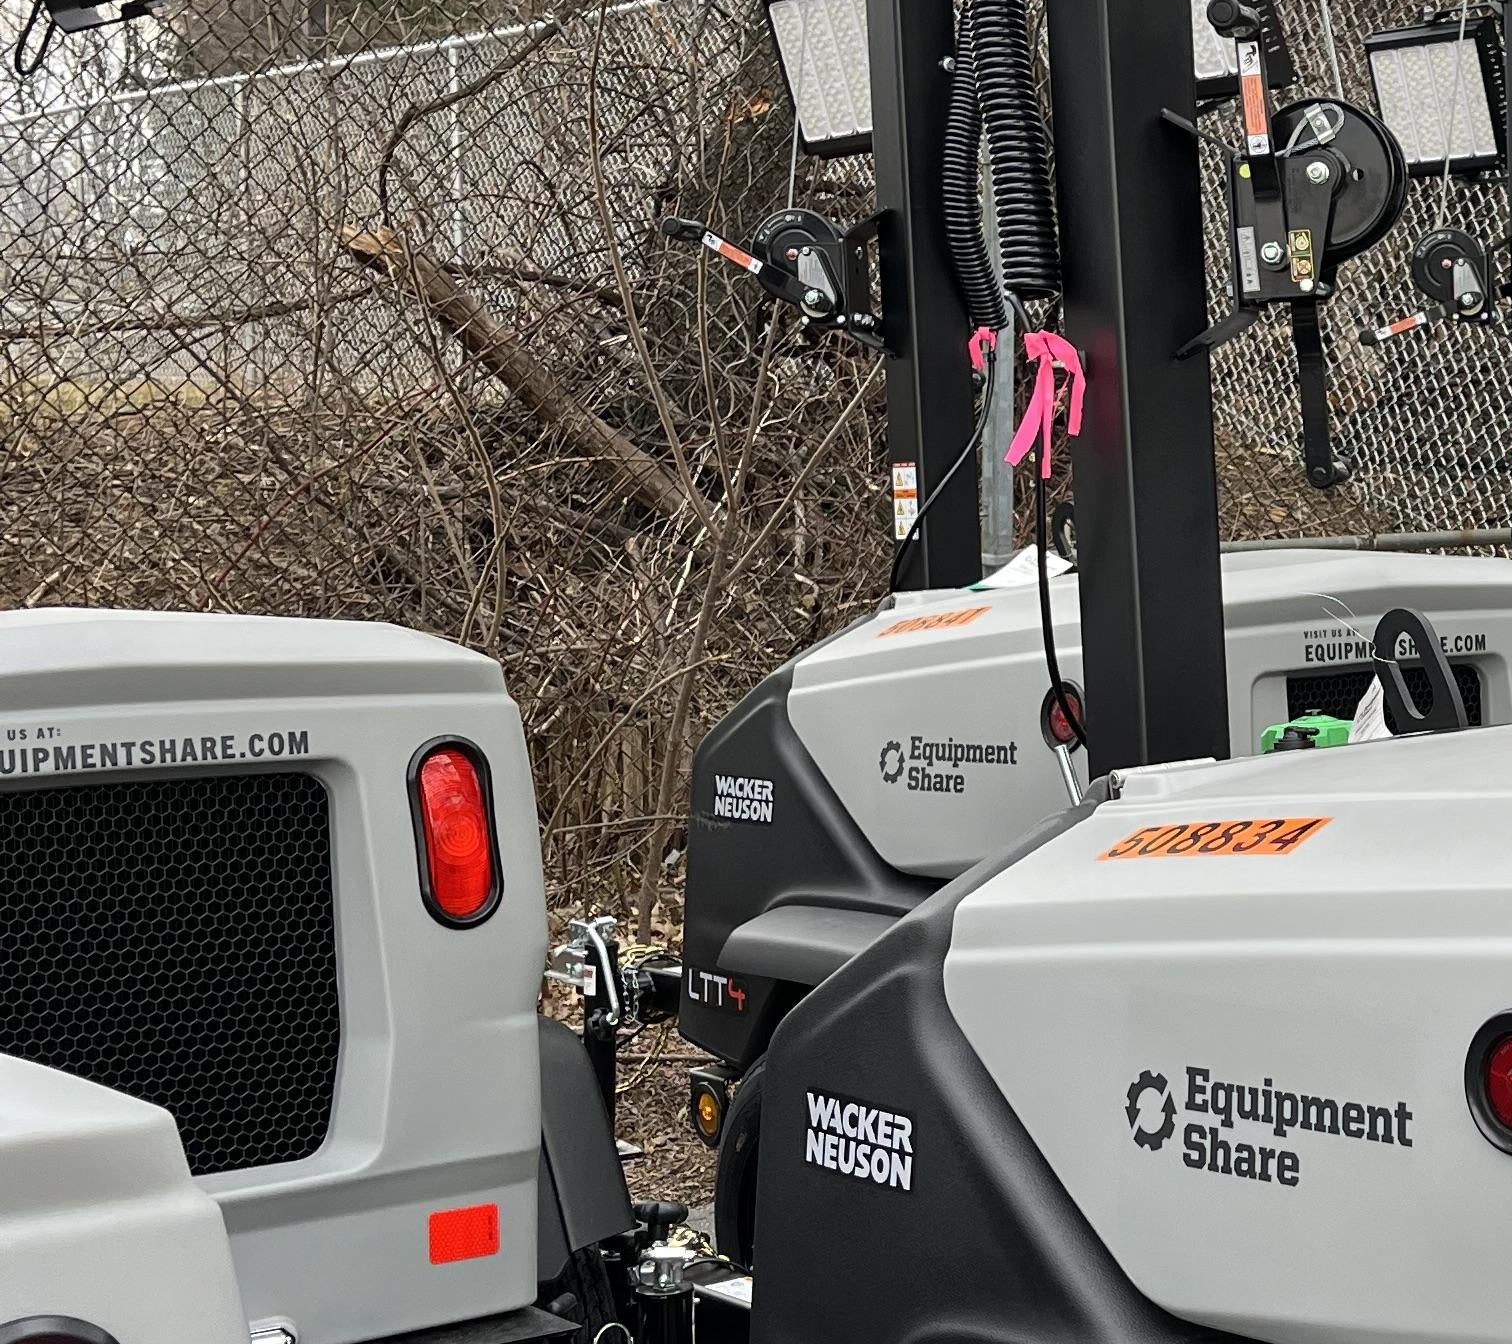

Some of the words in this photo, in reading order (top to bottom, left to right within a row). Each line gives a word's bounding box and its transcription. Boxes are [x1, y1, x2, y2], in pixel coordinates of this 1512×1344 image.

[1304, 629, 1327, 639] VISIT
[1331, 628, 1342, 638] US
[1305, 634, 1486, 662] EQUIPMSHE.COM
[7, 728, 27, 741] US
[36, 727, 61, 739] AT:
[909, 736, 1018, 768] Equipment
[715, 774, 773, 801] WACKER
[907, 766, 965, 793] Share
[714, 796, 773, 823] NEUSON
[1108, 819, 1322, 857] 508834
[689, 968, 746, 1010] LTT4
[806, 1092, 913, 1153] WACKER
[1185, 1066, 1413, 1147] Equipment
[806, 1128, 912, 1191] NEUSON
[1182, 1123, 1300, 1187] Share
